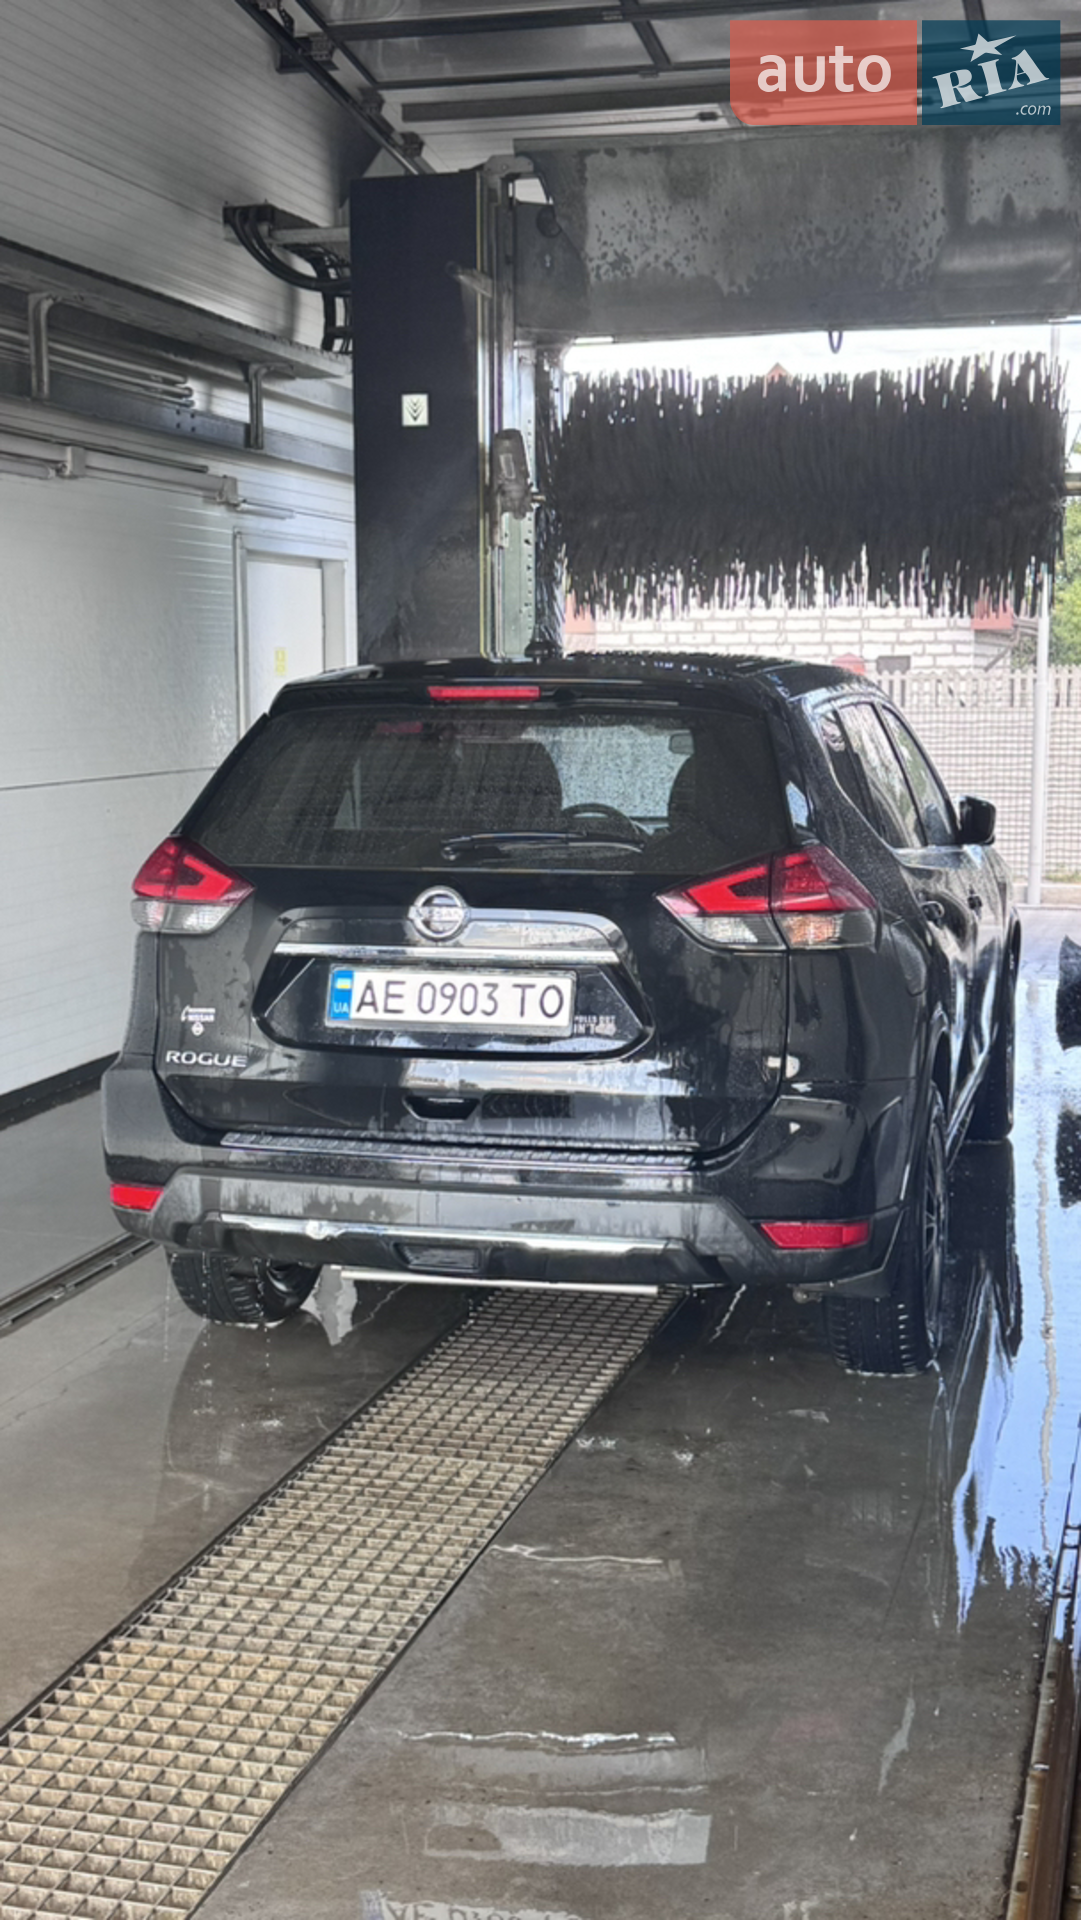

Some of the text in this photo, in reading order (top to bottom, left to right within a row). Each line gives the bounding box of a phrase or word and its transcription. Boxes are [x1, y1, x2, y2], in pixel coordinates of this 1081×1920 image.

[333, 1002, 350, 1014] UA
[355, 980, 564, 1018] AE 0903 TO
[165, 1050, 248, 1068] ROGUE
